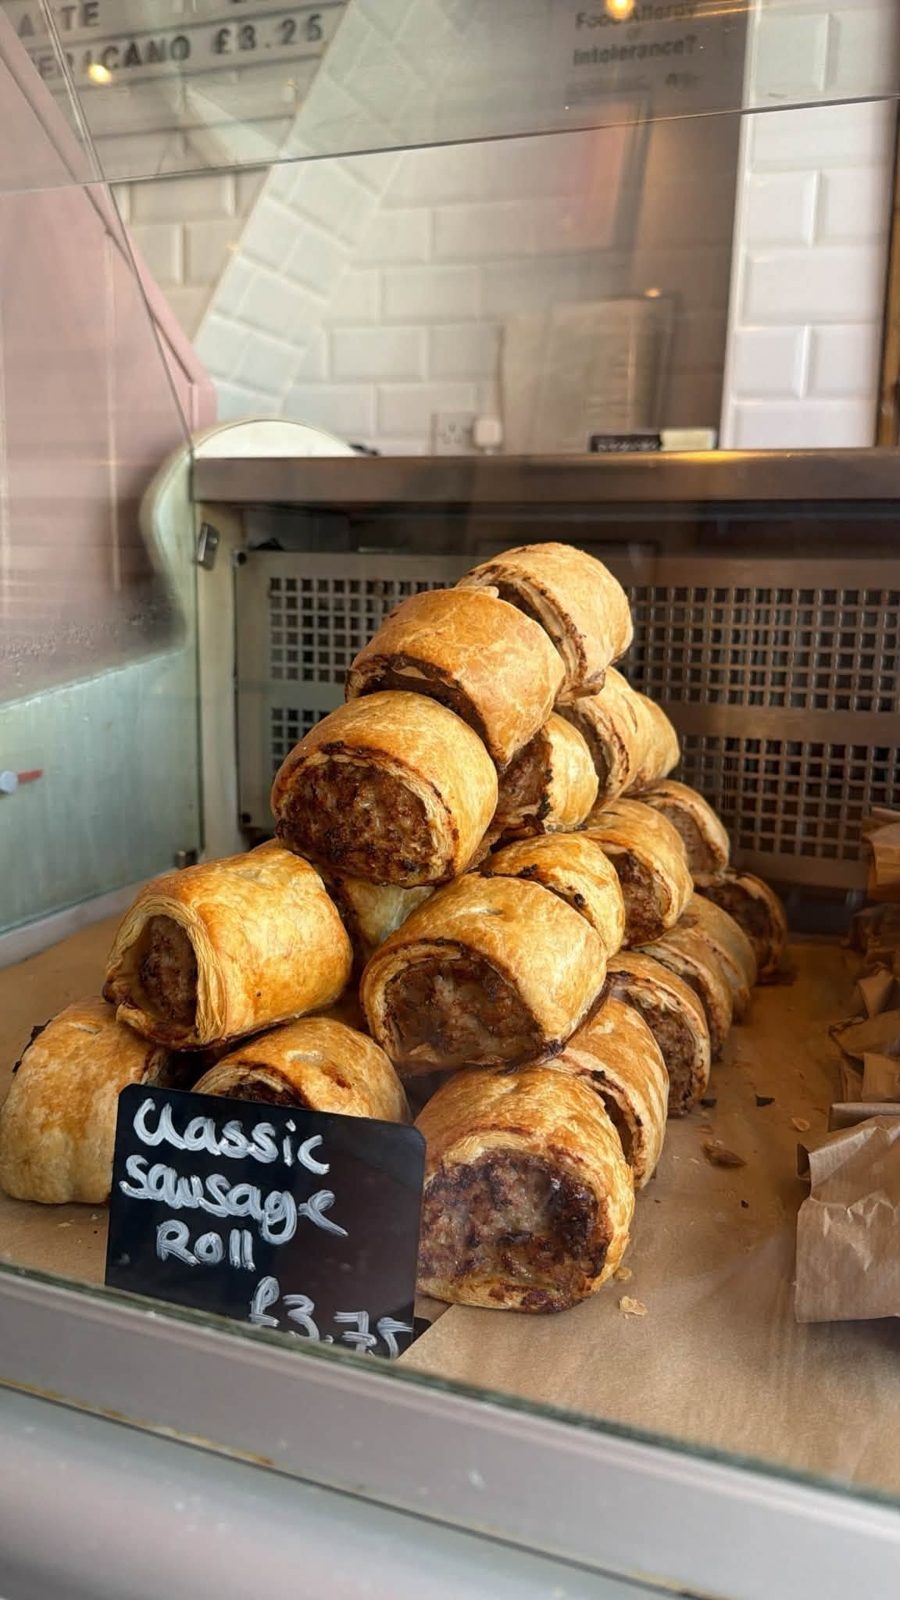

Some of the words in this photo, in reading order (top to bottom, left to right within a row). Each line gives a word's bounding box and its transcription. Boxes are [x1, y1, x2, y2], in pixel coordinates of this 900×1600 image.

[574, 33, 698, 66] Intolerance?
[133, 1098, 330, 1175] Classic
[156, 1219, 256, 1272] Roll
[249, 1275, 414, 1360] £3.75
